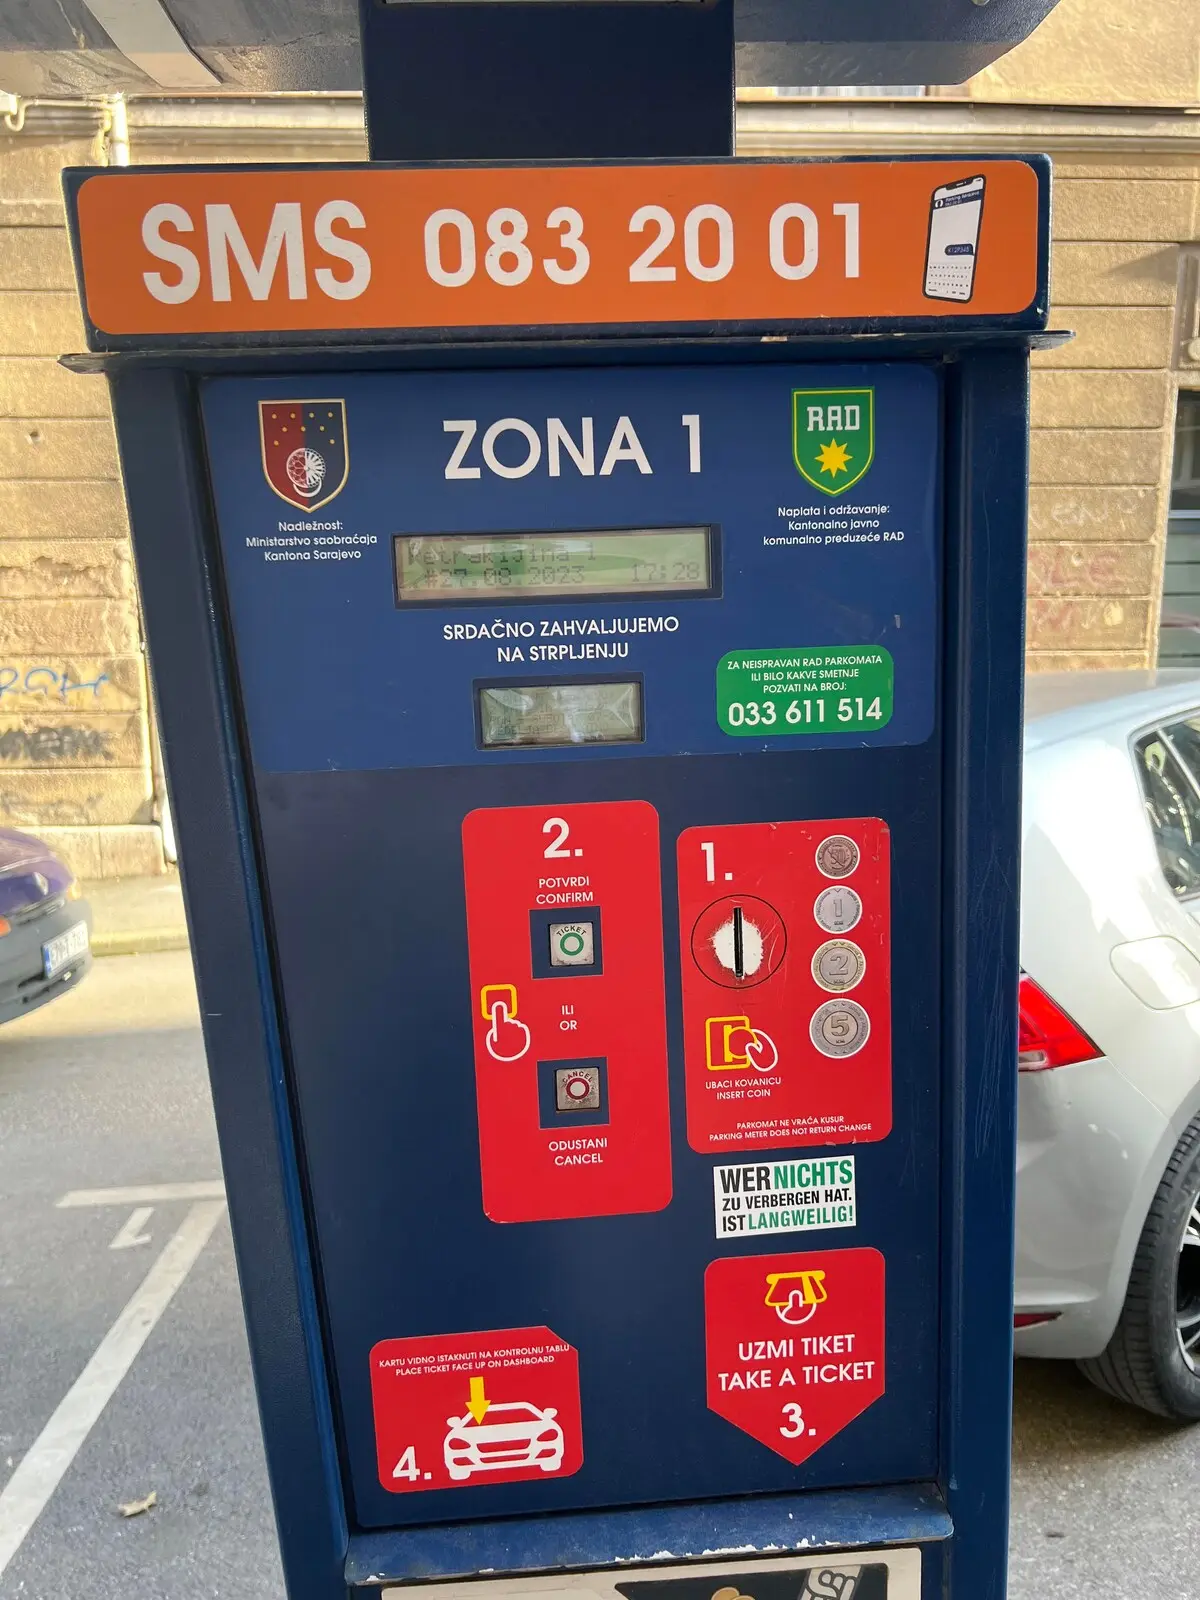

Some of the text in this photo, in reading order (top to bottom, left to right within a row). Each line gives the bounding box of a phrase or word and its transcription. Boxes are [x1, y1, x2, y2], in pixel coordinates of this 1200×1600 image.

[141, 199, 860, 304] SMS 083 20 01
[806, 405, 860, 432] RAD
[443, 414, 701, 479] ZONA 1
[778, 504, 890, 518] Naplata i održavanje:
[278, 520, 343, 532] Nadležnost:
[788, 519, 880, 531] Kantonalno javno
[246, 533, 378, 548] Ministarstvo saobraćaja
[763, 531, 905, 546] komunalno preduzeće RAD
[264, 549, 362, 562] Kantona Sarajevo
[632, 562, 700, 582] 17:28
[443, 616, 679, 640] SRDAČNO ZAHVALJUJEMO
[497, 642, 629, 662] NA STRPLJENJU
[727, 655, 883, 670] ZA NEISPRAVAN RAD PARKOMATA
[751, 668, 859, 682] ILI BILO KAKVE SMETNJE
[763, 682, 847, 694] POZVATI NA BROJ:
[728, 696, 883, 726] 033 611 514
[542, 817, 583, 859] 2.
[701, 842, 733, 882] 1.
[538, 876, 590, 889] POTVRDI
[536, 891, 594, 905] CONFIRM
[833, 899, 843, 918] 1
[556, 925, 587, 937] TICKET
[828, 955, 849, 976] 2
[561, 1005, 574, 1016] ILI
[559, 1020, 578, 1031] OR
[830, 1014, 850, 1037] 5
[562, 1070, 593, 1083] CANCEL
[705, 1077, 781, 1089] UBACI KOVANICU
[717, 1089, 771, 1100] INSERT COIN
[737, 1115, 844, 1130] PARKOMAT NE VRAĆA KUSUR
[709, 1123, 872, 1141] PARKING METER DOES NOT RETURN CHANGE
[549, 1138, 608, 1151] ODUSTANI
[554, 1153, 603, 1166] CANCEL
[720, 1159, 853, 1194] WER NICHTS
[722, 1188, 852, 1211] ZU VERBERGEN HAT.
[722, 1205, 853, 1232] IST LANGWEILIG!
[379, 1344, 570, 1368] KARTU VIDNO ISTAKNUTI NA KONTROLNU TABLU
[738, 1334, 855, 1361] UZMI TIKET
[395, 1355, 555, 1376] PLACE TICKET FACE UP ON DASHBOARD
[718, 1361, 875, 1391] TAKE A TICKET
[779, 1402, 816, 1438] 3.
[392, 1446, 432, 1482] 4.
